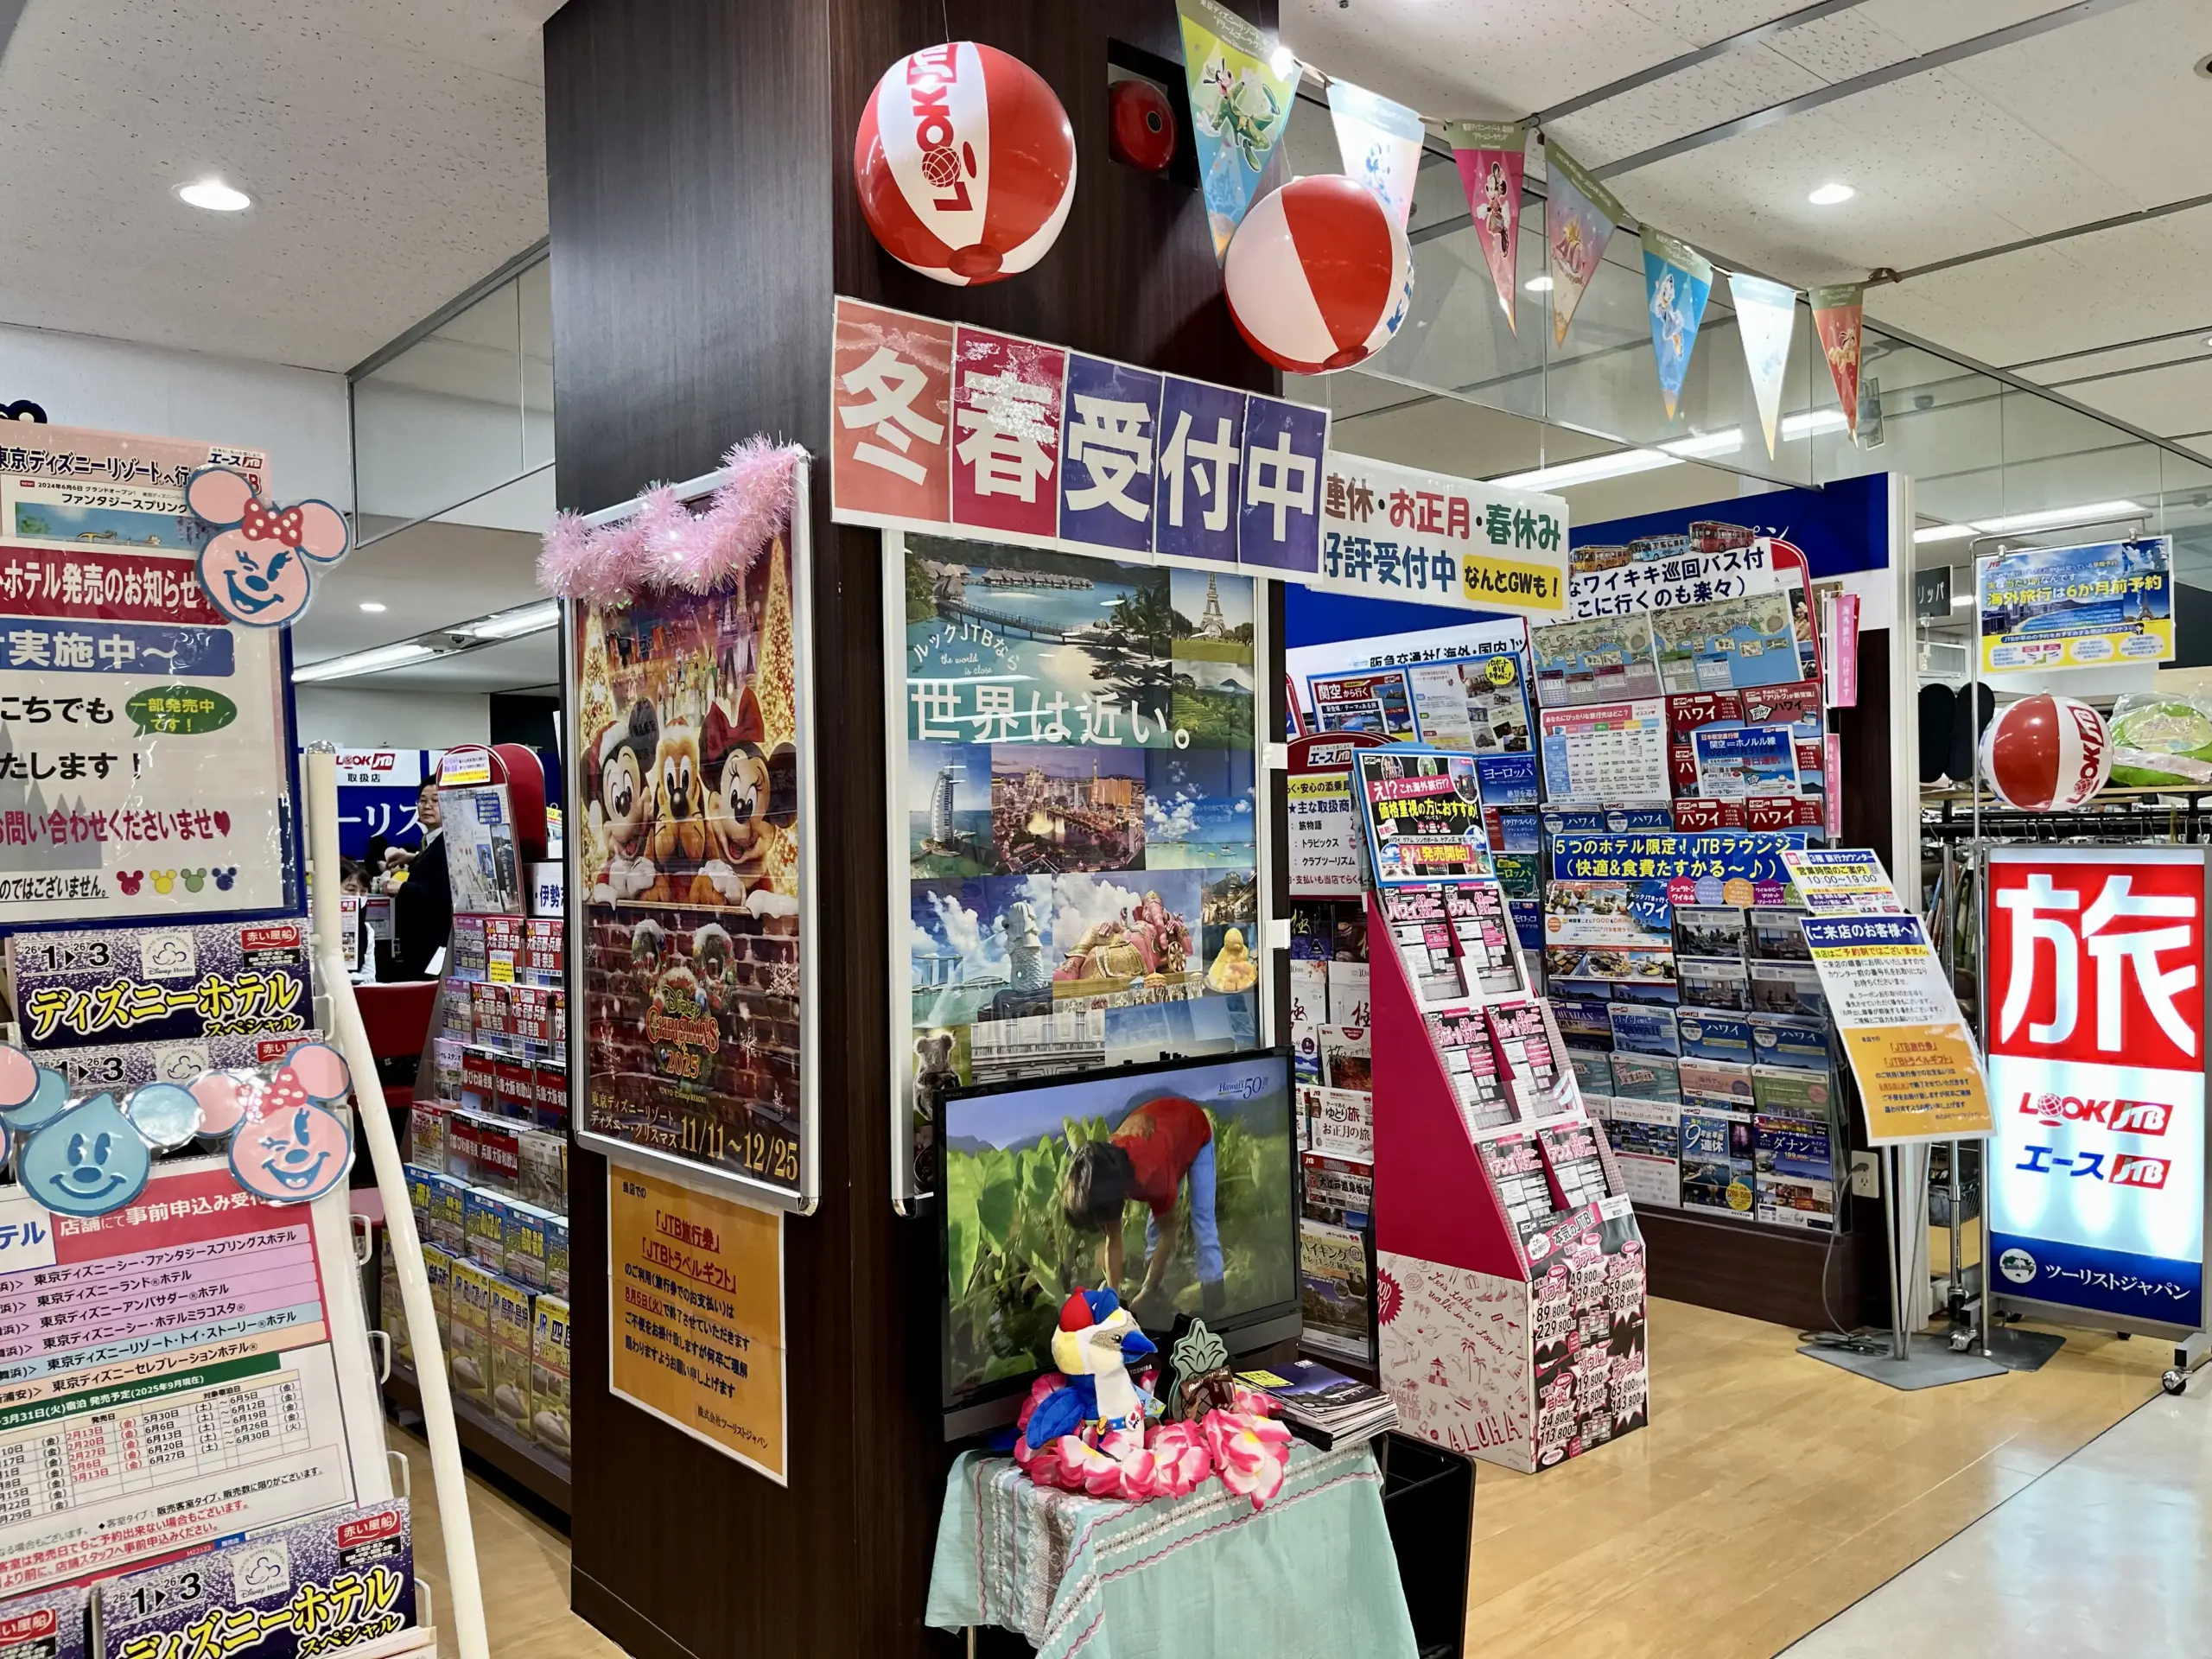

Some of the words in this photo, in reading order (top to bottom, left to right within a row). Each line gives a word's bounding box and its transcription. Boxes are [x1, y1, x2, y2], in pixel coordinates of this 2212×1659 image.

[912, 85, 973, 211] LOOK
[837, 346, 1316, 543] 冬春受付中
[207, 453, 241, 467] エース
[1569, 575, 1745, 619] こに行くのも楽々）
[0, 629, 177, 670] 実施中～
[940, 654, 953, 664] the
[955, 654, 979, 664] world
[964, 666, 972, 675] is
[973, 666, 993, 675] close
[1318, 683, 1343, 701] 関空
[911, 682, 1190, 750] 世界は近い。
[1678, 705, 1716, 721] ハワイ
[1772, 700, 1802, 711] ハワイ
[2068, 705, 2105, 749] JTB
[372, 753, 395, 770] JTB
[1308, 752, 1334, 765] エース
[347, 772, 380, 783] 取扱店
[1484, 764, 1533, 779] ヨーロッパ
[1298, 798, 1354, 814] 主な取扱商
[1299, 821, 1322, 830] 旅物語
[1567, 817, 1597, 827] ハワイ
[1632, 814, 1662, 825] ハワイ
[1681, 813, 1719, 827] ハワイ
[1753, 809, 1795, 825] ハワイ
[1797, 866, 1866, 875] 営業時間のご案内
[539, 884, 563, 907] 伊勢
[1627, 901, 1669, 919] ハワイ
[246, 929, 292, 943] 赤い風船
[41, 945, 57, 969] 1
[89, 942, 111, 967] 3
[1996, 873, 2197, 1059] 旅
[30, 972, 301, 1038] ディズニーホテル
[1707, 1023, 1738, 1036] ハワイ
[1781, 1030, 1815, 1042] ハワイ
[103, 1057, 124, 1082] 3
[666, 1051, 700, 1078] 2025
[2018, 1090, 2112, 1127] LOOK
[2107, 1098, 2174, 1137] JTB
[1323, 1125, 1370, 1141] お正月の旅
[1774, 1137, 1811, 1152] ダナン
[2015, 1145, 2105, 1181] エース
[2108, 1154, 2172, 1190] JTB
[2044, 1262, 2191, 1301] ツーリストジャパン
[1449, 1290, 1472, 1313] take
[1538, 1280, 1566, 1305] ハワイ
[1428, 1290, 1455, 1313] walk
[1453, 1308, 1465, 1323] in
[539, 1313, 548, 1334] JR
[1130, 1364, 1153, 1376] TOSHIBA
[1545, 1389, 1567, 1412] 台北
[67, 1426, 103, 1440] 2月13日
[143, 1410, 179, 1424] 5月30日
[230, 1392, 258, 1404] 6月5日
[92, 1413, 115, 1424] 発売日
[145, 1421, 175, 1434] 6月6日
[232, 1401, 265, 1414] 6月12日
[1447, 1410, 1523, 1454] ALOHA
[73, 1468, 109, 1483] 3月13日
[149, 1451, 185, 1465] 6月27日
[236, 1430, 270, 1444] 6月30日
[344, 1513, 396, 1538] 赤い風船
[0, 1522, 218, 1588] より前に、店舗スタッフへ事前申込みください。
[130, 1587, 146, 1615] 1
[180, 1572, 200, 1601] 3
[267, 1580, 287, 1593] Hotels
